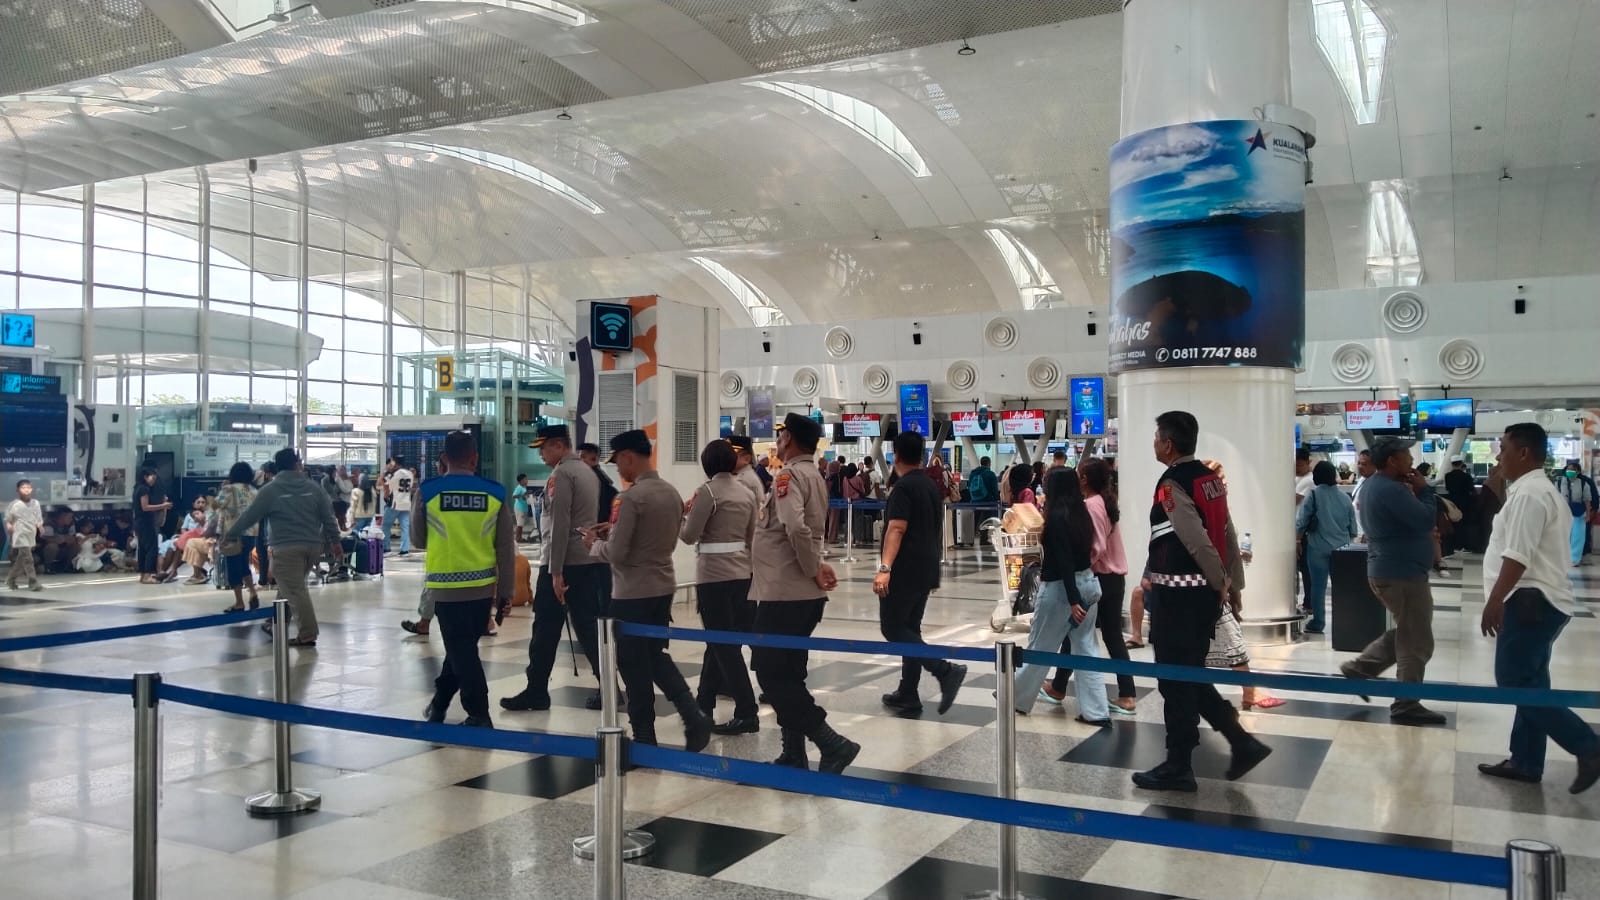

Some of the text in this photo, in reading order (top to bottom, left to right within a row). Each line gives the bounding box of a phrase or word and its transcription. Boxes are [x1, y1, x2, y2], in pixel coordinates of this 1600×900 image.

[1172, 347, 1257, 359] 0811 7747 888
[440, 361, 451, 387] B
[443, 495, 486, 509] POLISI
